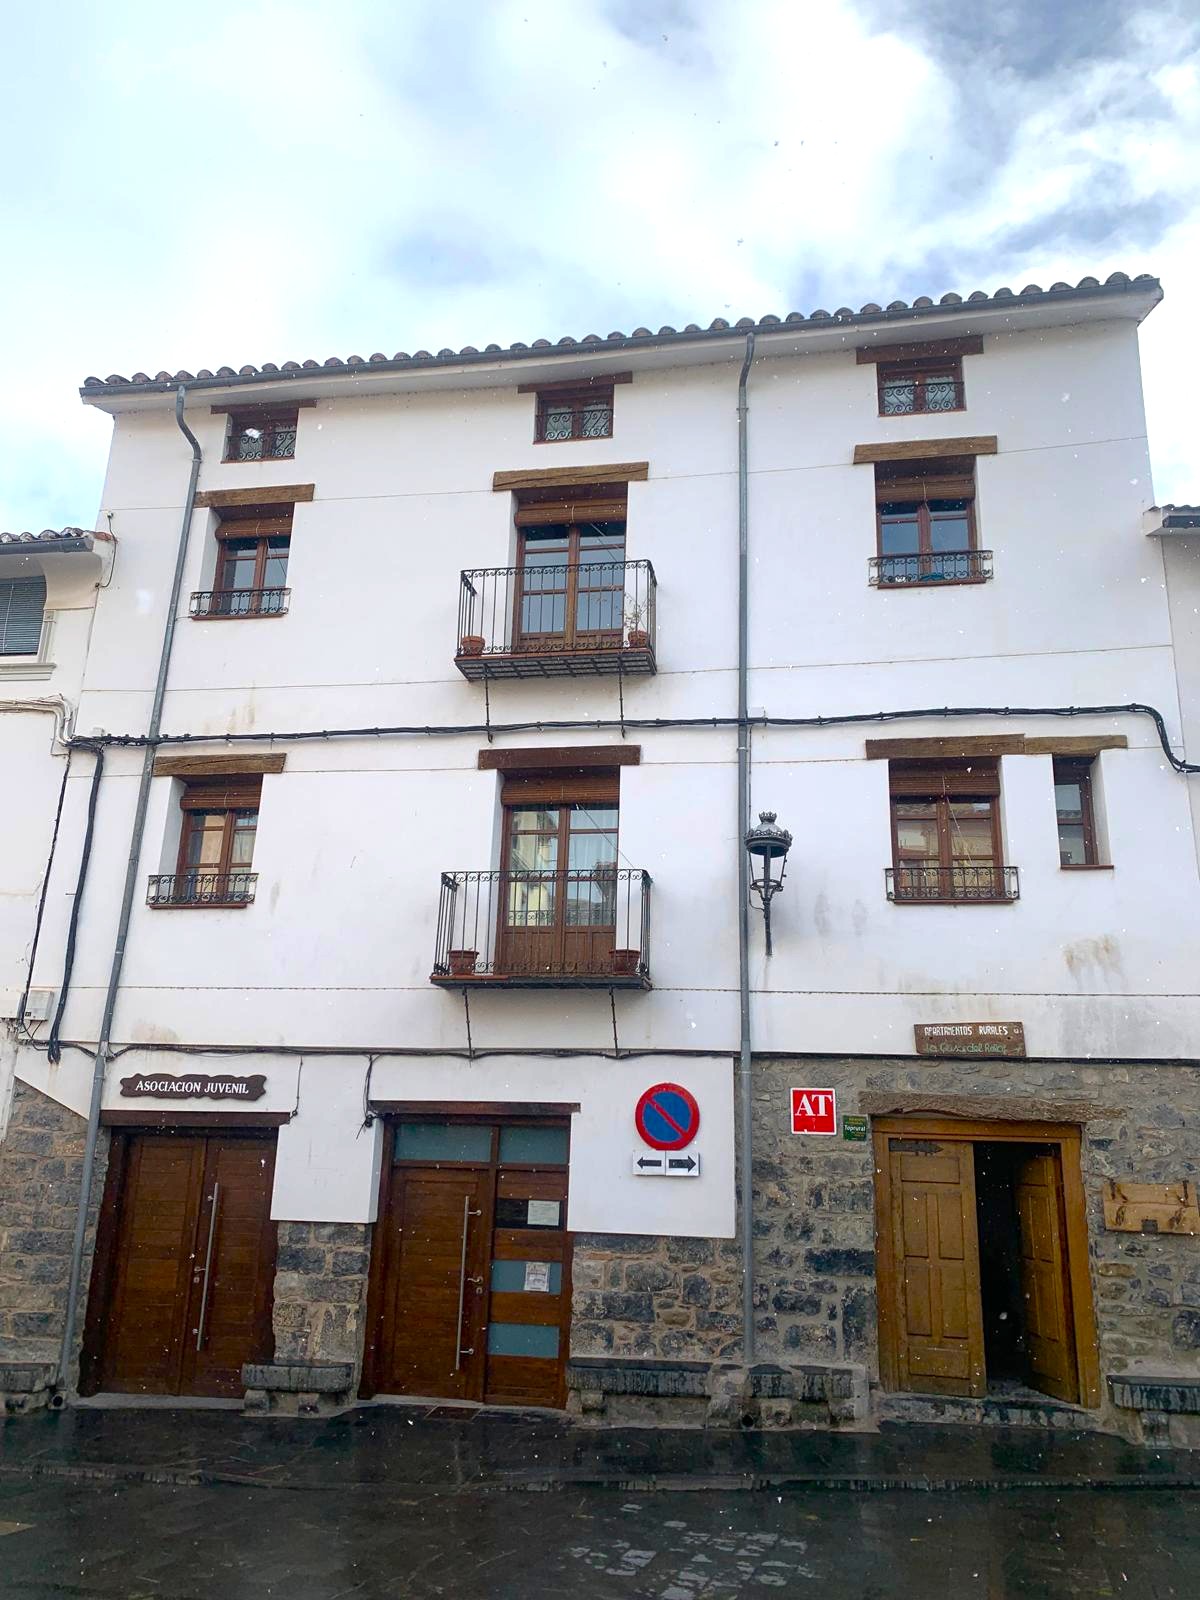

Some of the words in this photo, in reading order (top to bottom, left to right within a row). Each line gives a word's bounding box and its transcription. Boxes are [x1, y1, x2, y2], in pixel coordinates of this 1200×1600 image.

[924, 1026, 973, 1036] APARTAMENTOS
[979, 1025, 1009, 1036] RURALES
[135, 1080, 201, 1093] ASOCIACION
[204, 1082, 249, 1094] JUVENIL
[794, 1093, 833, 1117] AT
